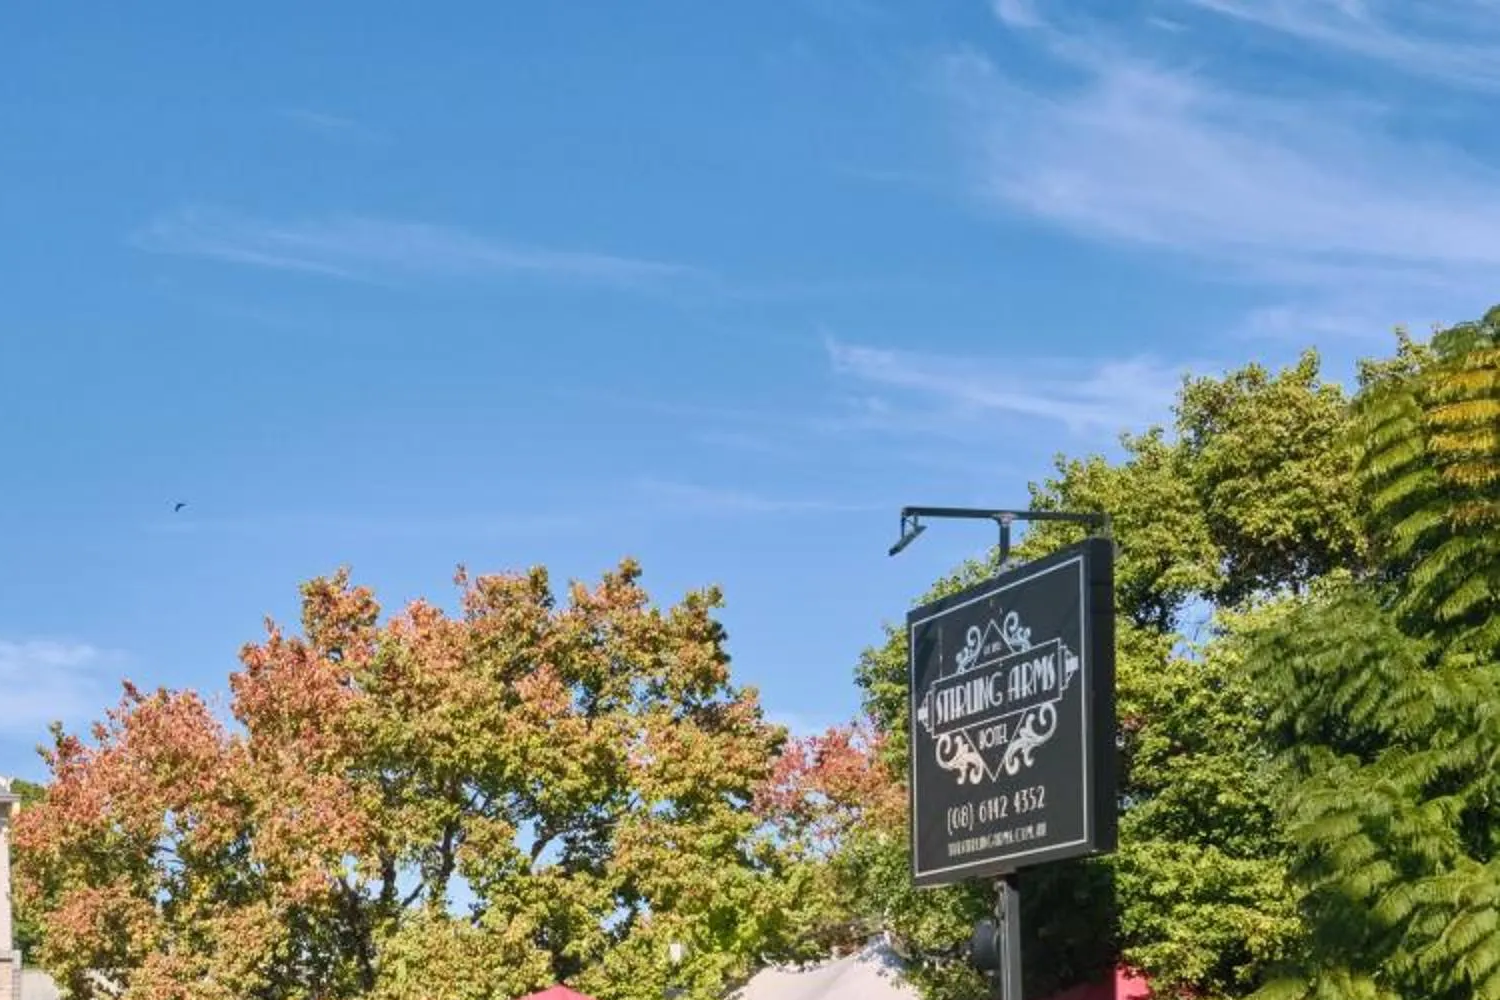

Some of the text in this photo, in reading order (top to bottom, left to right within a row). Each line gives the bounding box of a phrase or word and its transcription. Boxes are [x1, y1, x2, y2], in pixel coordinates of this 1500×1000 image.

[936, 652, 1056, 726] STIRLING ARMS
[947, 801, 974, 836] (08)
[1014, 785, 1045, 814] 4352
